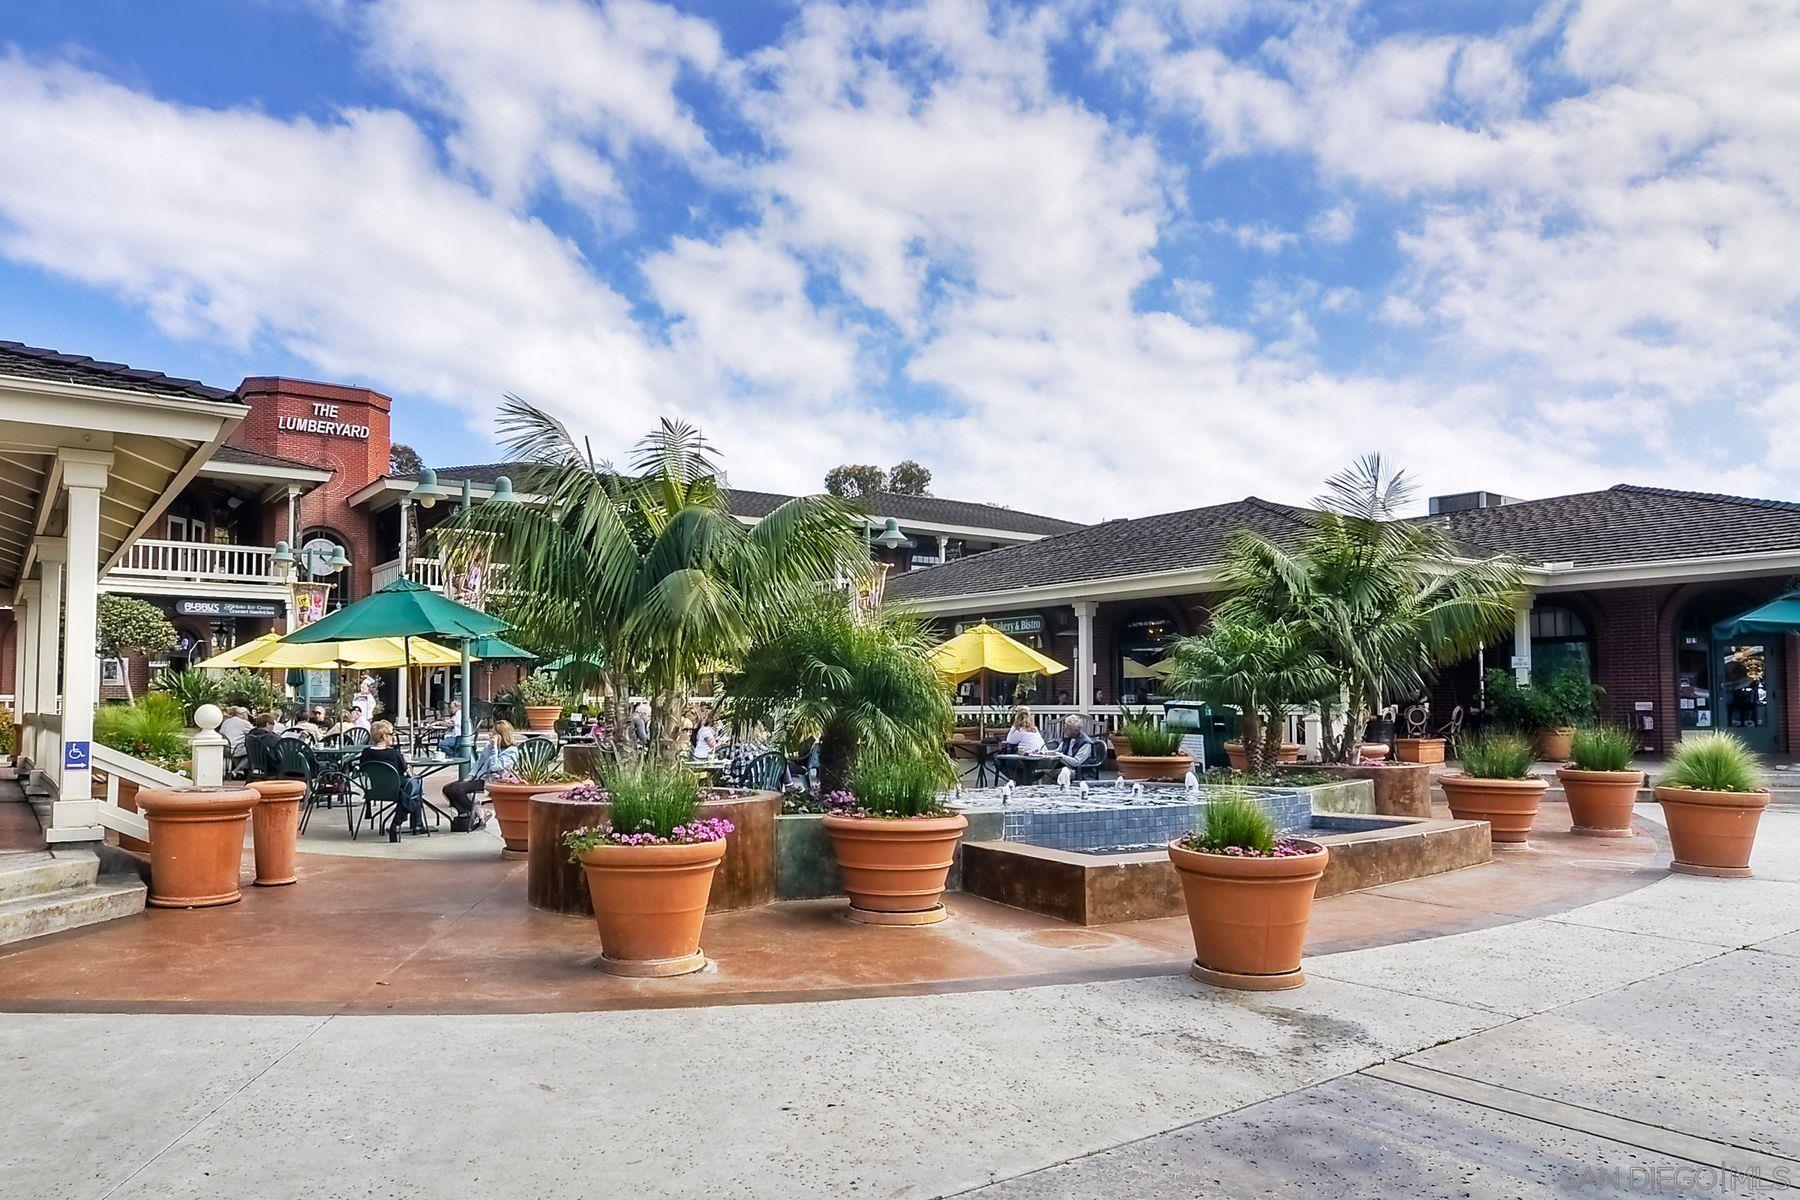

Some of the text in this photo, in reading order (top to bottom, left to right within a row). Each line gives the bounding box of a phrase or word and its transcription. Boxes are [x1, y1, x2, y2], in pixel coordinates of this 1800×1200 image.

[313, 402, 339, 418] THE
[278, 416, 369, 438] LUMBERYARD
[1014, 620, 1020, 630] &
[1021, 618, 1041, 630] Bistro
[1700, 712, 1708, 721] A
